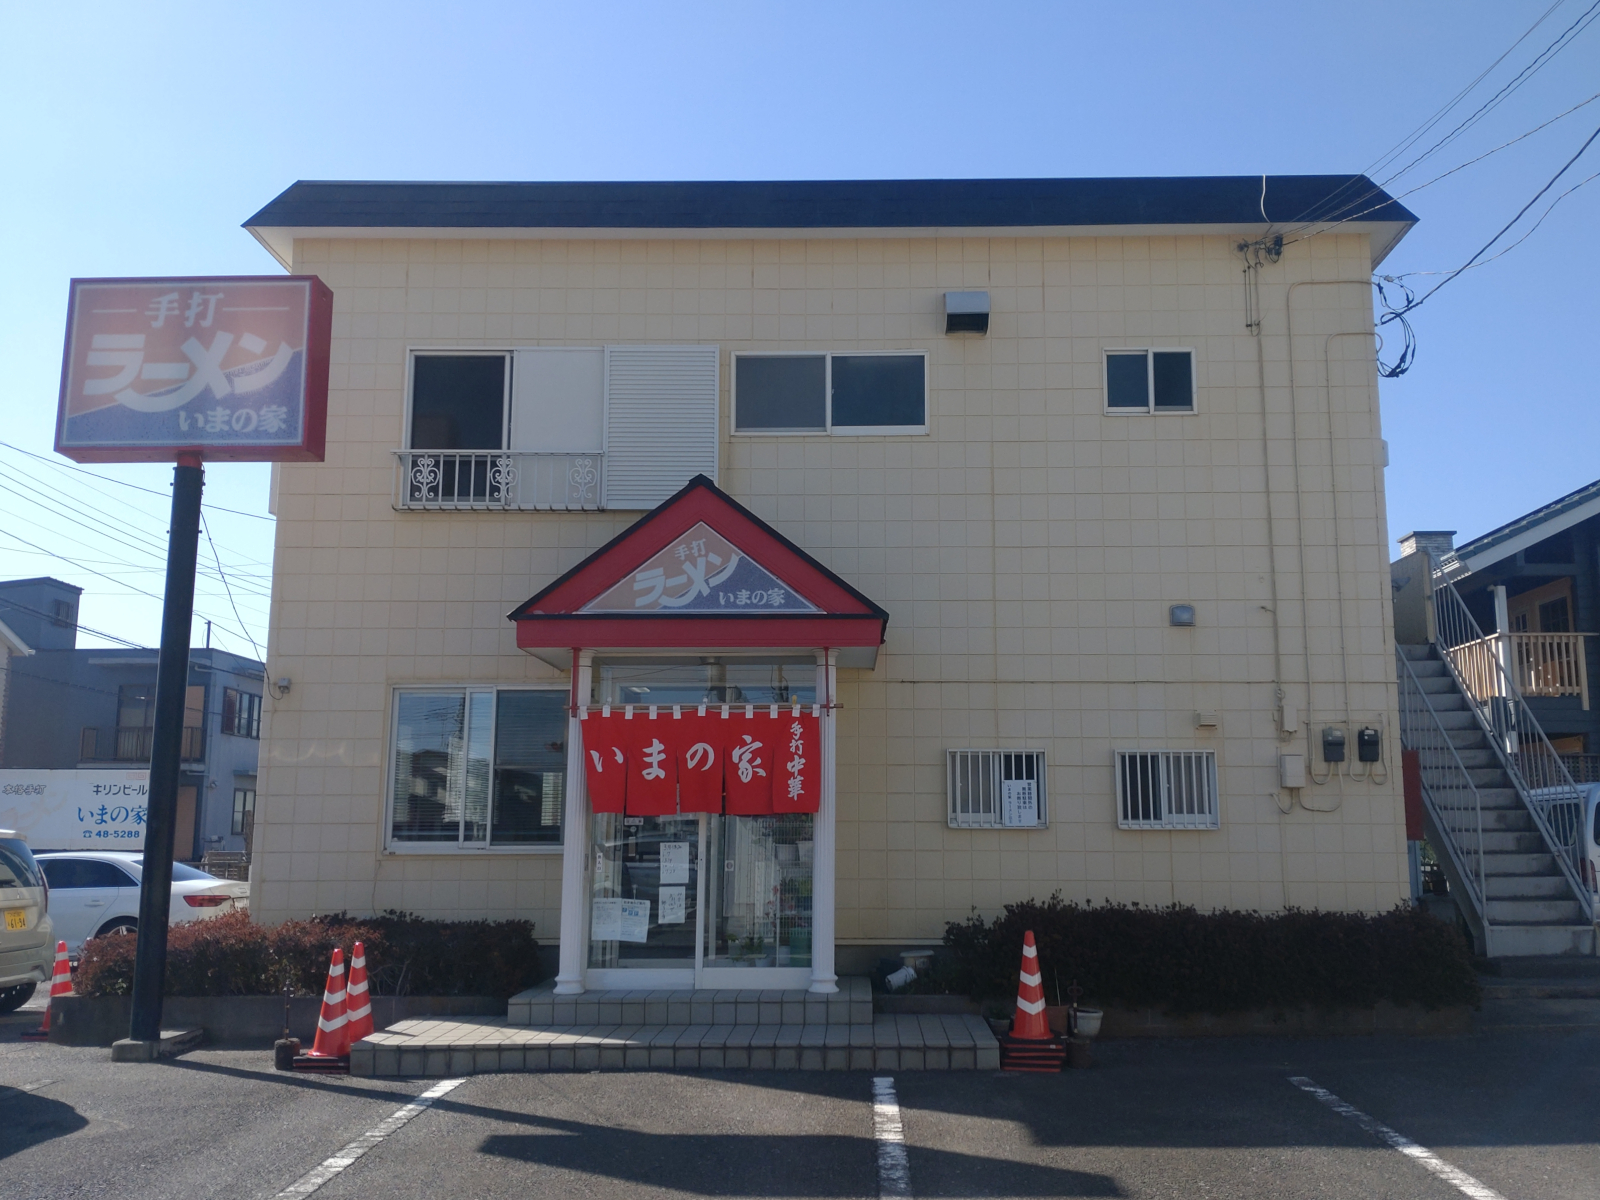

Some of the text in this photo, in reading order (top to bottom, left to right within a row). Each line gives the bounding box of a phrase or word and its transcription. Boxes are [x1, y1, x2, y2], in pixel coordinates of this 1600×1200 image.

[144, 291, 224, 329] 手打
[83, 330, 294, 412] ラーメン
[179, 404, 287, 433] いまの家
[674, 538, 706, 560] 手打
[633, 552, 740, 608] ラーメン
[719, 588, 785, 606] いまの家
[589, 735, 767, 783] いまの家
[786, 721, 806, 801] 手打中華
[2, 783, 47, 796] 本格手打
[92, 784, 148, 796] キリンビール
[77, 804, 148, 826] いまの家
[95, 830, 140, 839] 48-5288
